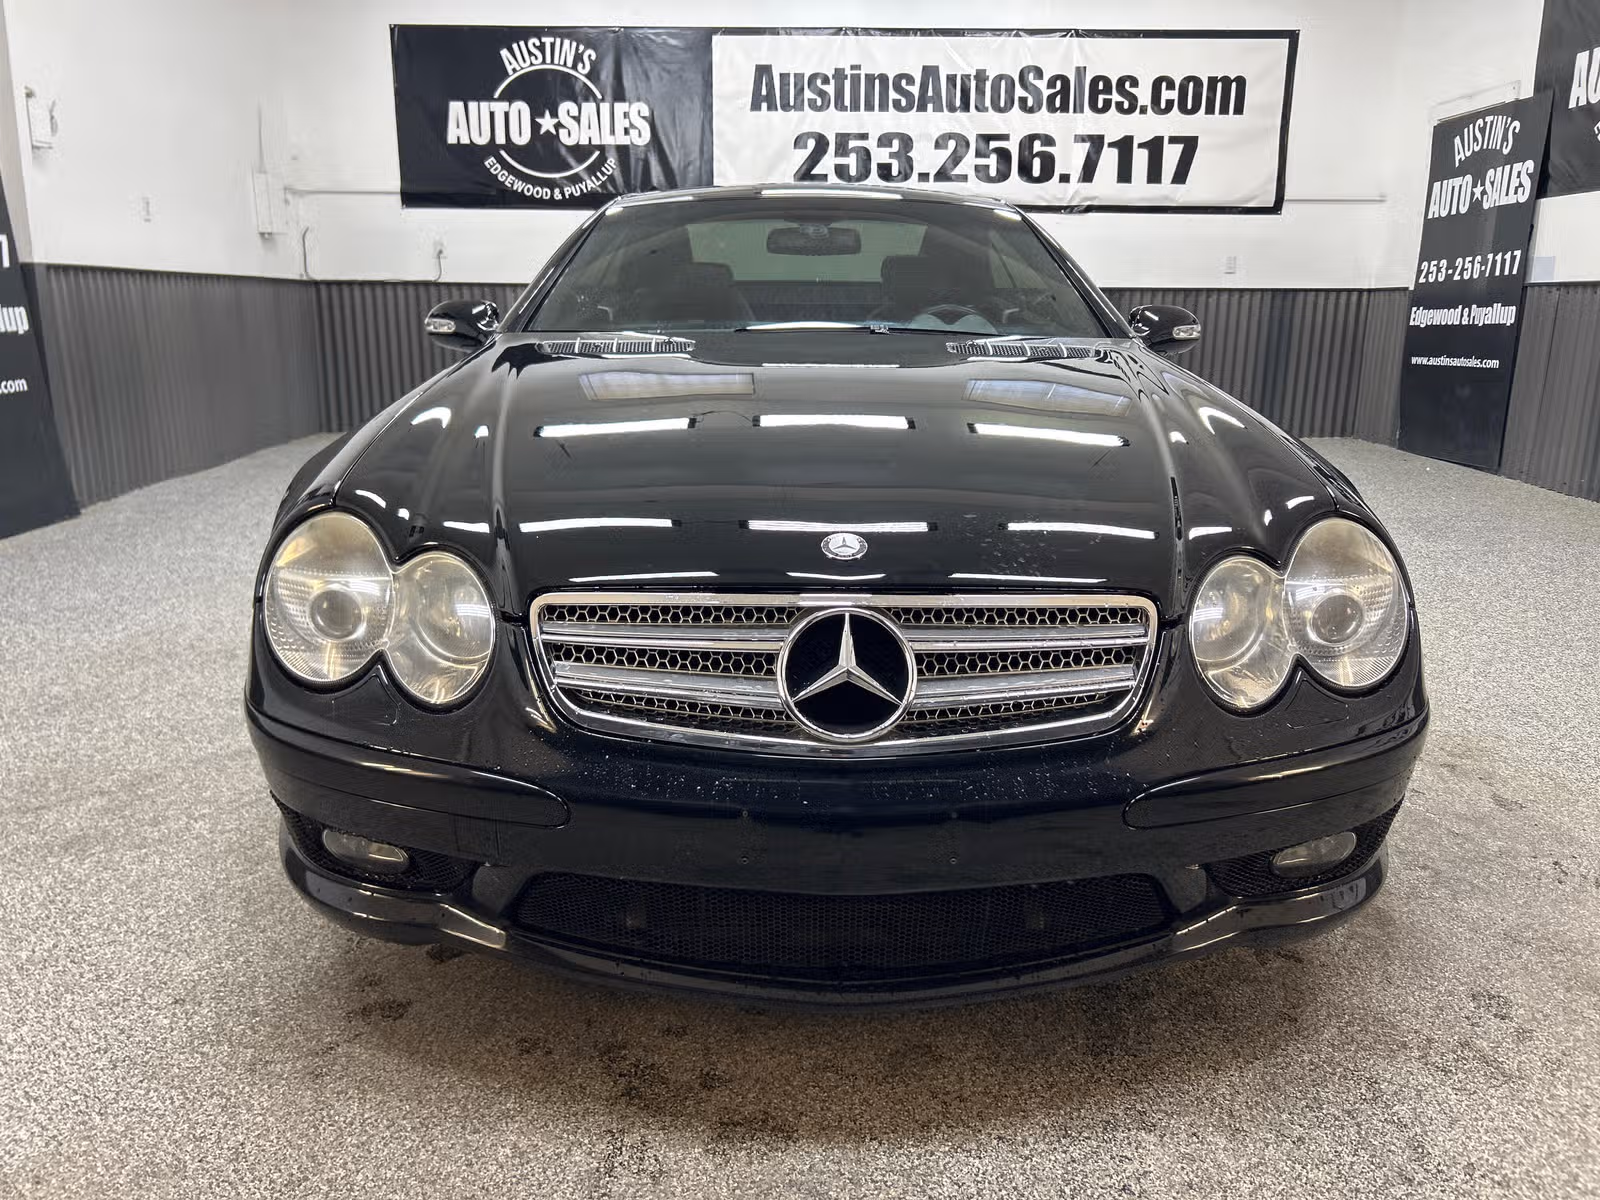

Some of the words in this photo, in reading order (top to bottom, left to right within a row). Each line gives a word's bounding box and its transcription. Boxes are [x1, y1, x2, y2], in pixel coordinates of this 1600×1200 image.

[500, 36, 596, 75] AUSTIN'S
[749, 63, 1247, 115] AustinsAutoSales.com
[447, 101, 532, 145] AUTO
[558, 101, 650, 146] SALES
[1454, 115, 1521, 168] AUSTIN'S
[483, 155, 551, 200] EDGEWOOD
[553, 188, 562, 200] &
[564, 157, 618, 199] PUYALLUP
[793, 131, 1199, 185] 253.256.7117
[1427, 174, 1473, 219] AUTO
[1482, 159, 1535, 210] SALES
[1418, 250, 1522, 284] 253-256-7117
[1409, 305, 1462, 328] Edgewood
[1462, 307, 1469, 325] &
[1469, 303, 1517, 327] Puyallup
[1411, 354, 1500, 369] www.austinsautosales.com
